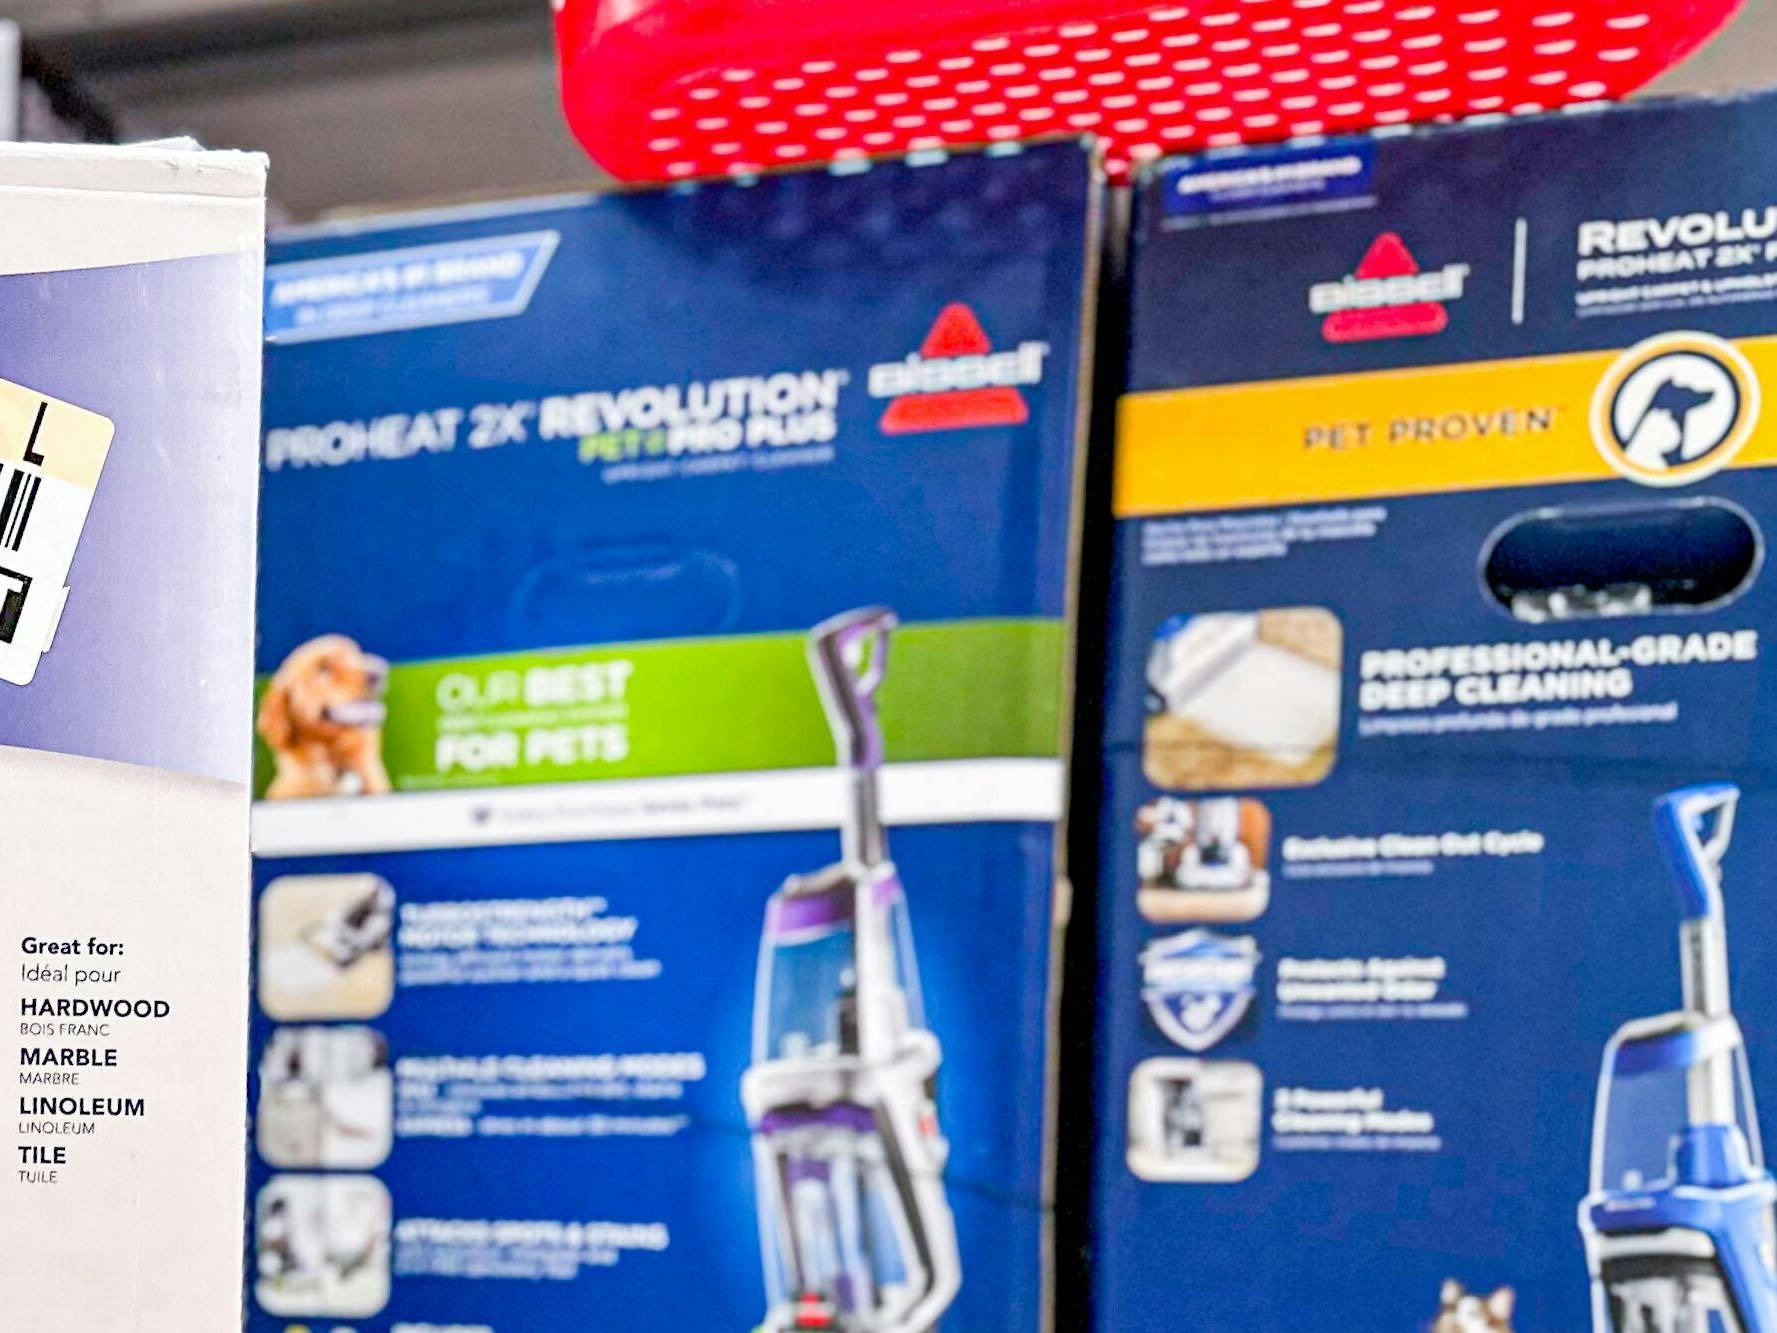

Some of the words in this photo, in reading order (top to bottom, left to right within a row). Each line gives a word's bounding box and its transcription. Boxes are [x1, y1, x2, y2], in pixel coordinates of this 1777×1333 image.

[538, 369, 850, 442] REVOLUTION
[21, 401, 49, 467] L
[1302, 420, 1373, 452] PET
[1388, 407, 1558, 443] PROVEN
[21, 936, 81, 956] Great
[87, 937, 125, 956] for:
[21, 964, 68, 983] Idéal
[74, 970, 122, 987] pour
[20, 998, 171, 1018] HARDWOOD
[19, 1022, 55, 1036] BOIS
[58, 1023, 111, 1037] FRANC
[20, 1047, 118, 1067] MARBLE
[19, 1072, 80, 1086] MARBRE
[19, 1096, 145, 1117] LINOLEUM
[18, 1121, 96, 1135] LINOLEUM
[17, 1145, 67, 1165] TILE
[18, 1170, 59, 1184] TUILE
